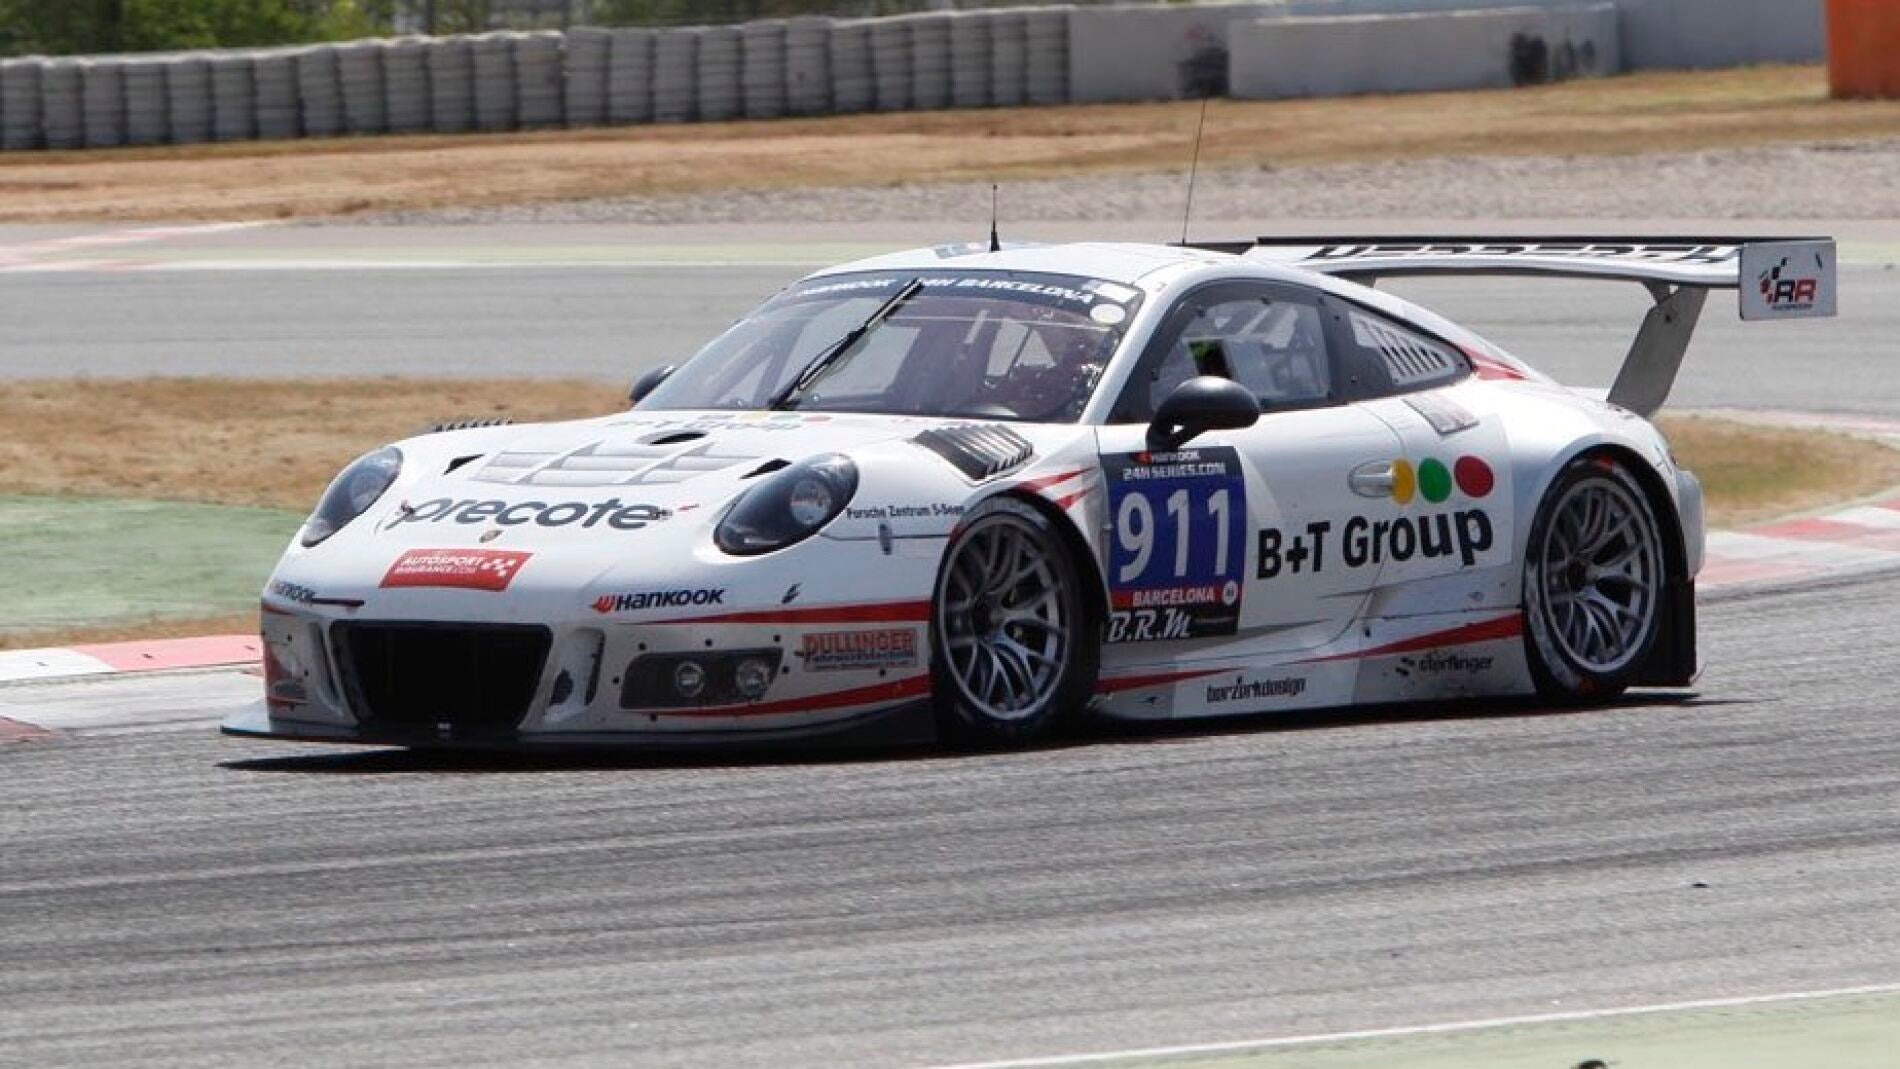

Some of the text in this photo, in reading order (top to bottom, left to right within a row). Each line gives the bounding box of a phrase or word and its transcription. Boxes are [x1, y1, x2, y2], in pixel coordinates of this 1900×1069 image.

[384, 498, 648, 530] precote
[1118, 488, 1229, 582] 911
[1257, 509, 1493, 580] B+T Group
[402, 555, 486, 567] AUTOSPORT
[1132, 587, 1215, 607] BARCELONA
